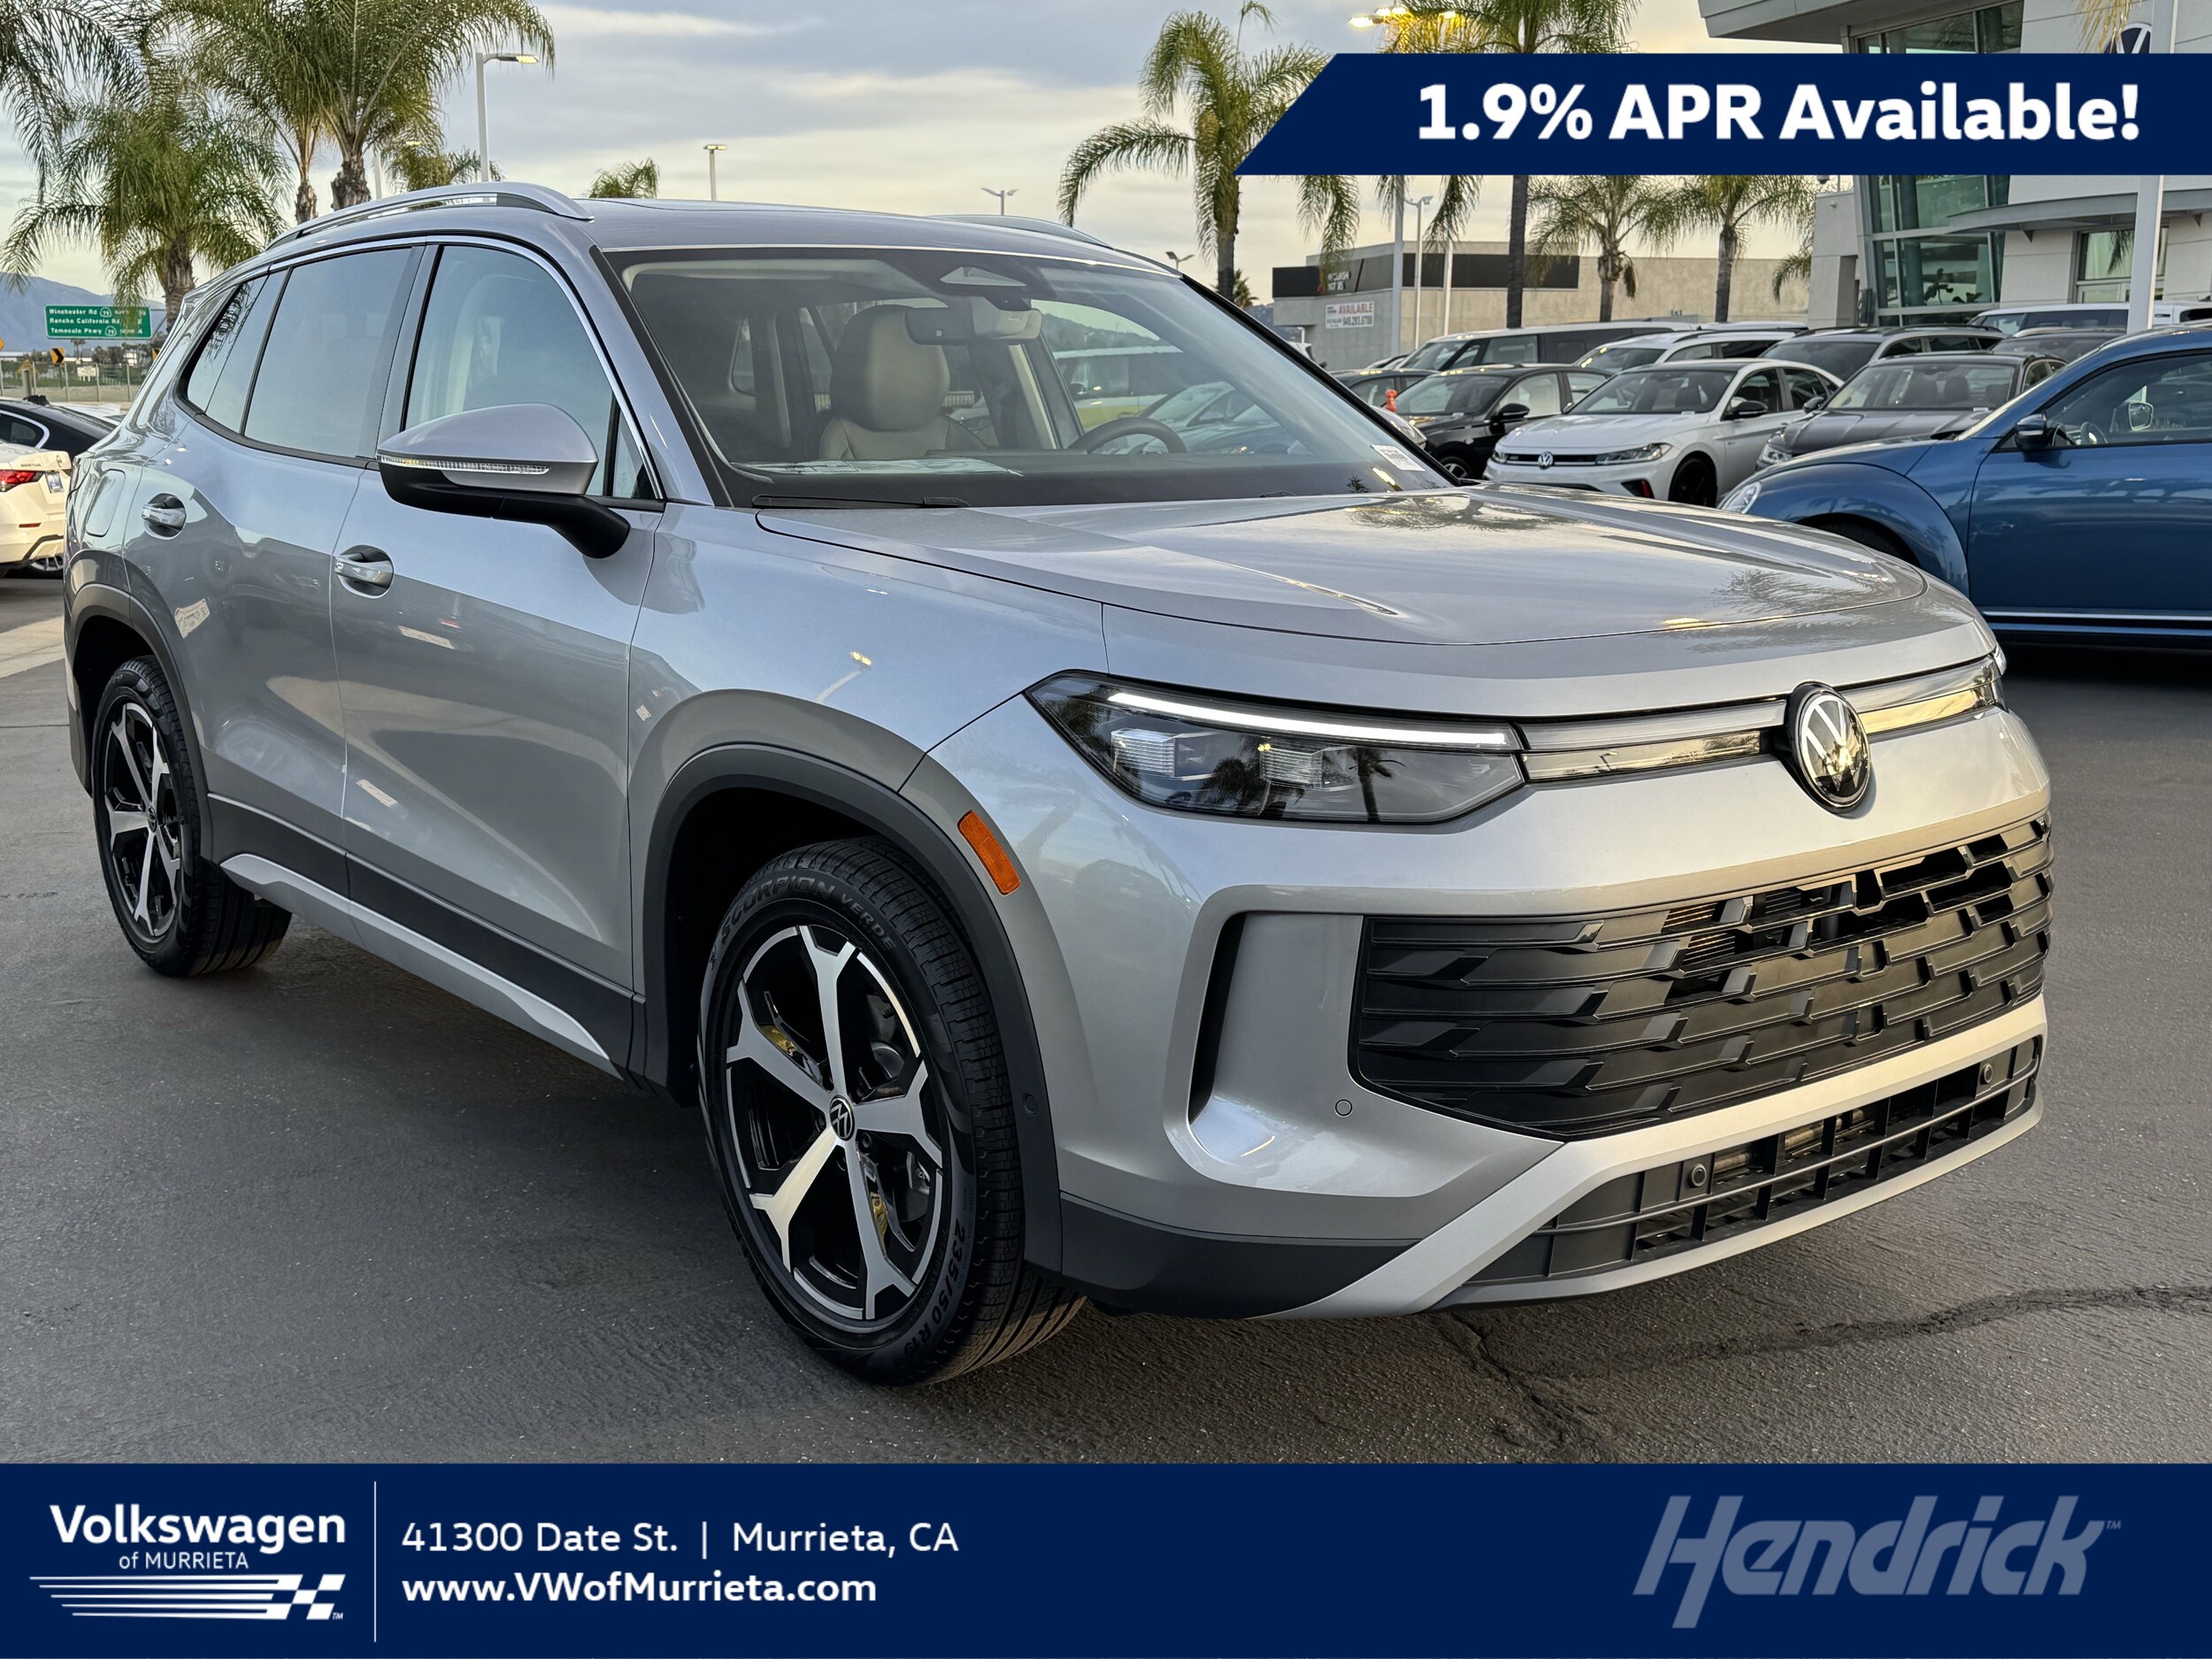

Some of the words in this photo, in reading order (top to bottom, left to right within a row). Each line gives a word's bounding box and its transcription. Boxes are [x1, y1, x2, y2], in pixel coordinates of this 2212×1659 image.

[1339, 303, 1373, 314] AVAILABLE
[721, 874, 835, 945] SCORPION
[841, 893, 897, 950] VERDE
[932, 1217, 965, 1323] 235/50
